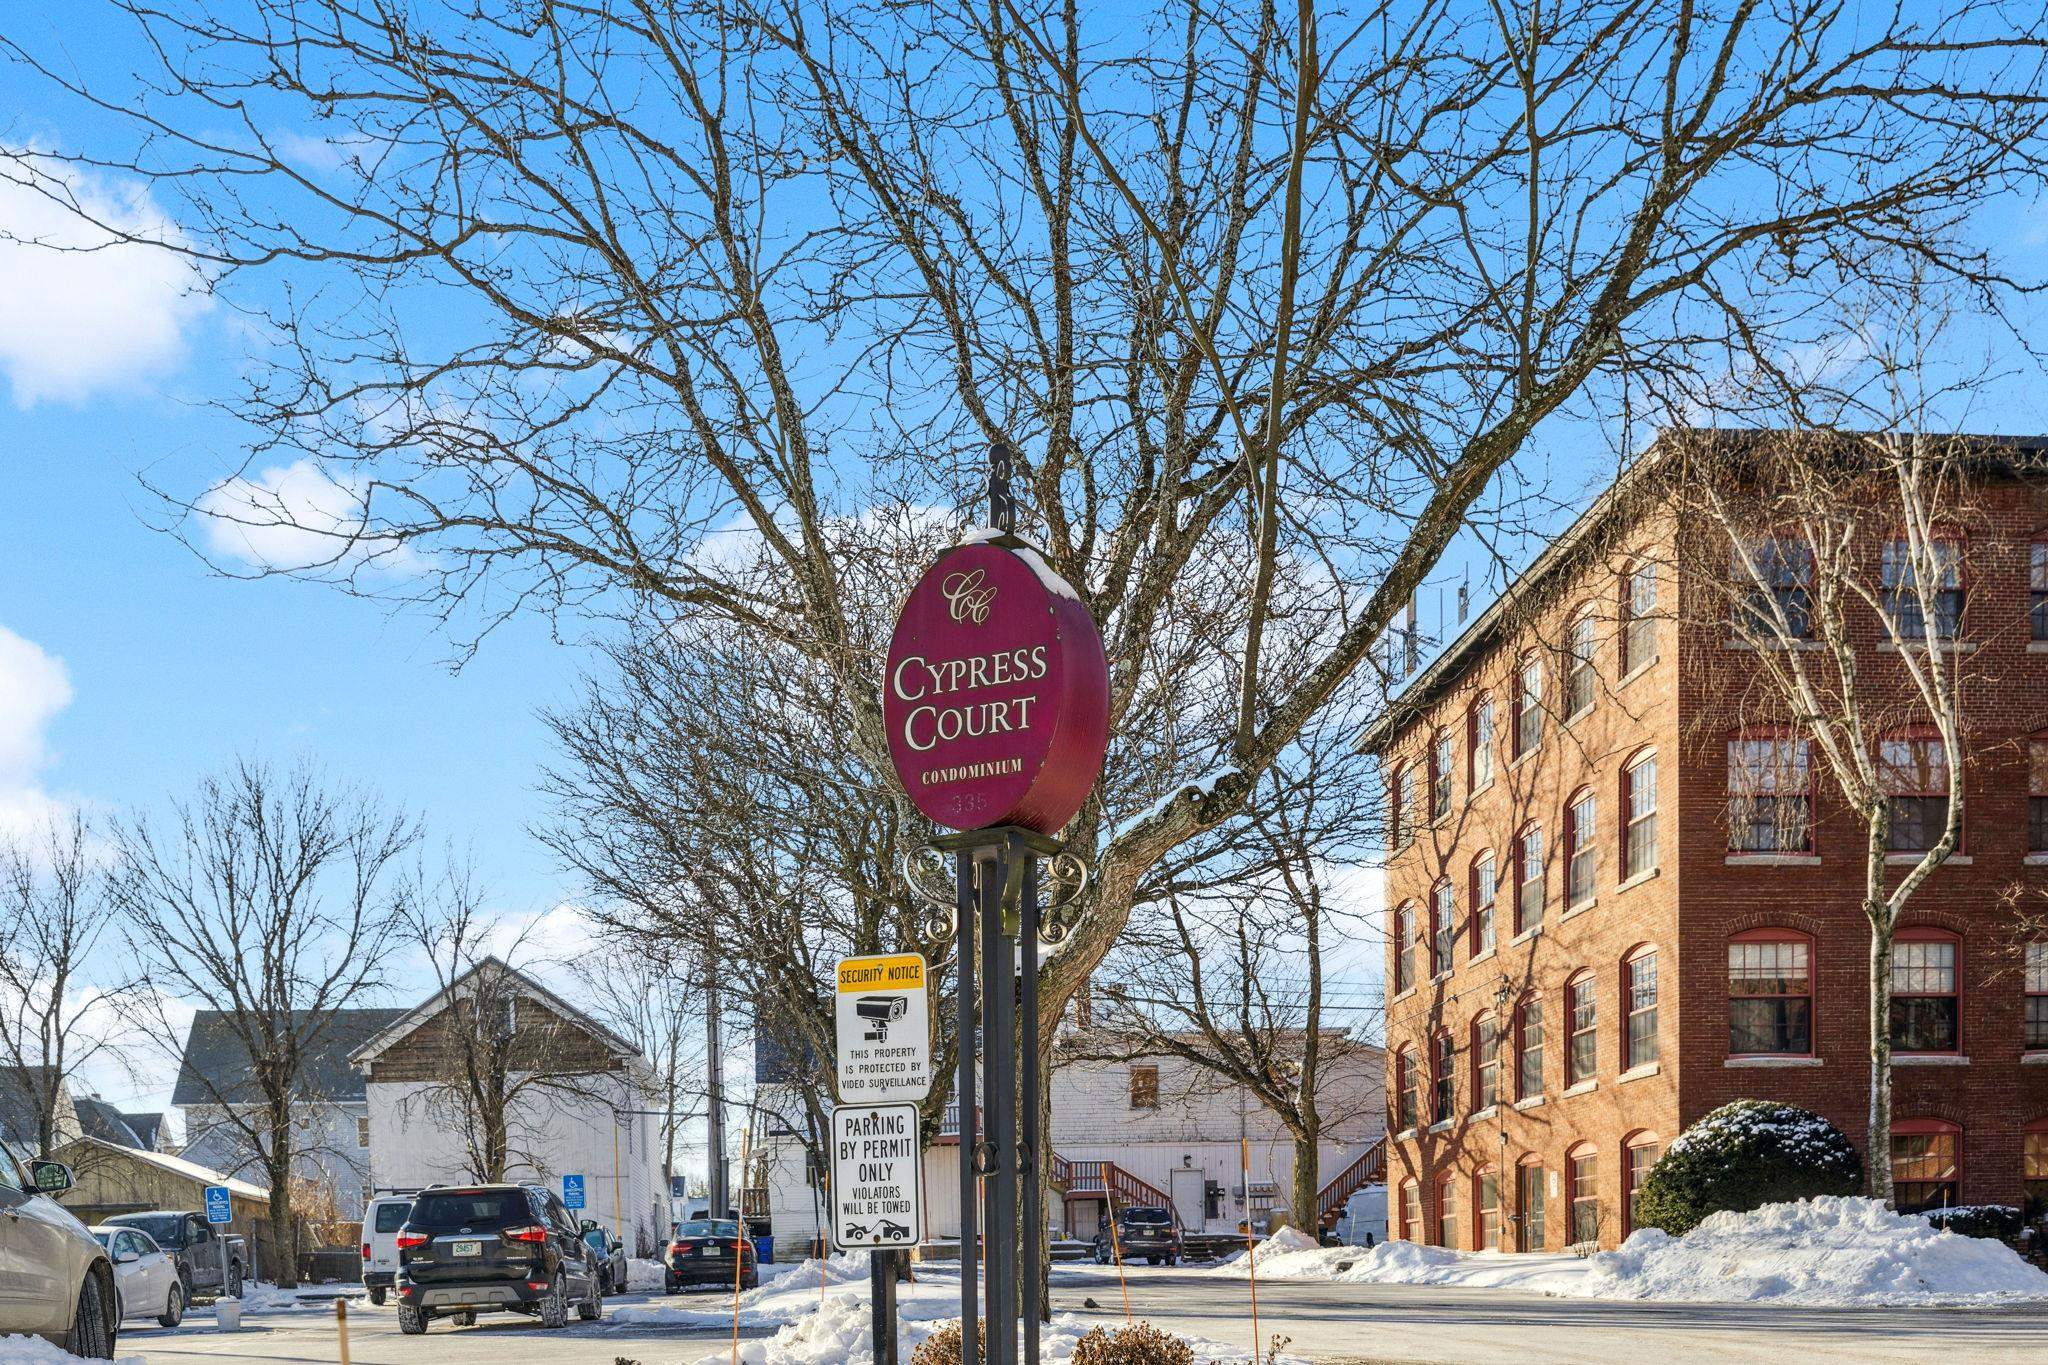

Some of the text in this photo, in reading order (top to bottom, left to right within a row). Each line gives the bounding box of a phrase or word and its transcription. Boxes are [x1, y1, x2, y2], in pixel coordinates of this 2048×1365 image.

[893, 646, 1047, 701] CYPRESS
[904, 695, 1036, 751] COURT
[922, 758, 1022, 785] CONDOMINIUM
[840, 965, 920, 984] SECURITY NOTICE
[850, 1047, 916, 1060] THIS PROPERTY
[845, 1062, 921, 1075] IS PROTECTED BY
[842, 1076, 927, 1089] VIDEO SURVEILLANCE
[845, 1115, 905, 1137] PARKING
[840, 1138, 911, 1160] BY PERMIT
[859, 1162, 893, 1182] ONLY
[852, 1186, 901, 1200] VIOLATORS
[842, 1200, 911, 1215] WILL BE TOWED
